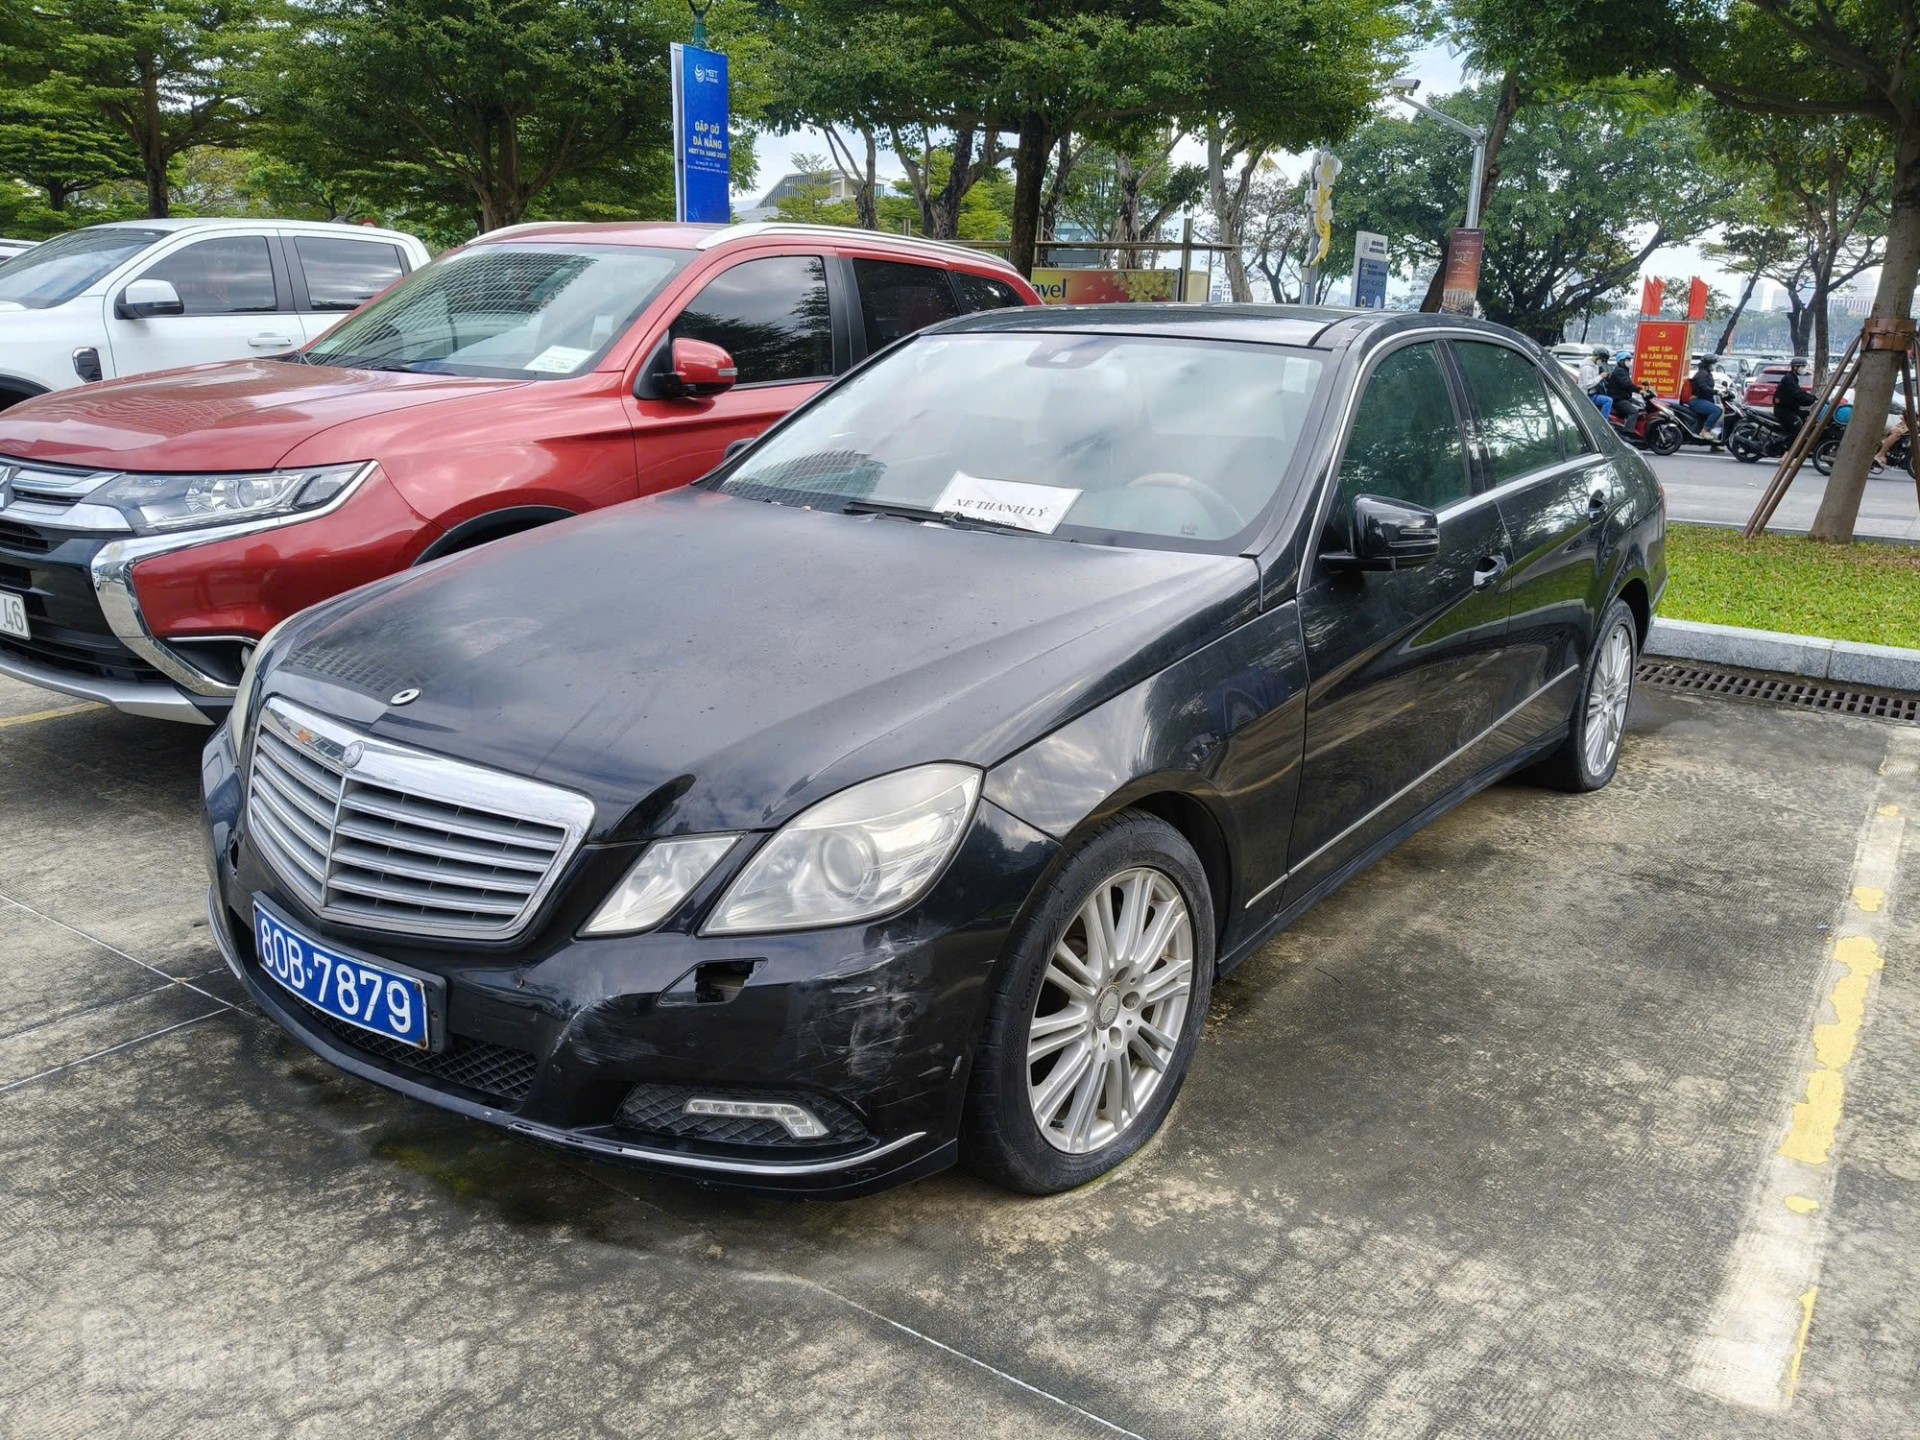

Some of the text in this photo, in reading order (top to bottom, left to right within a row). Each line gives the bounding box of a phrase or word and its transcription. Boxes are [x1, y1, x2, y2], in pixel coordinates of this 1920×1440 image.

[952, 498, 1049, 517] XE THANH LÝ
